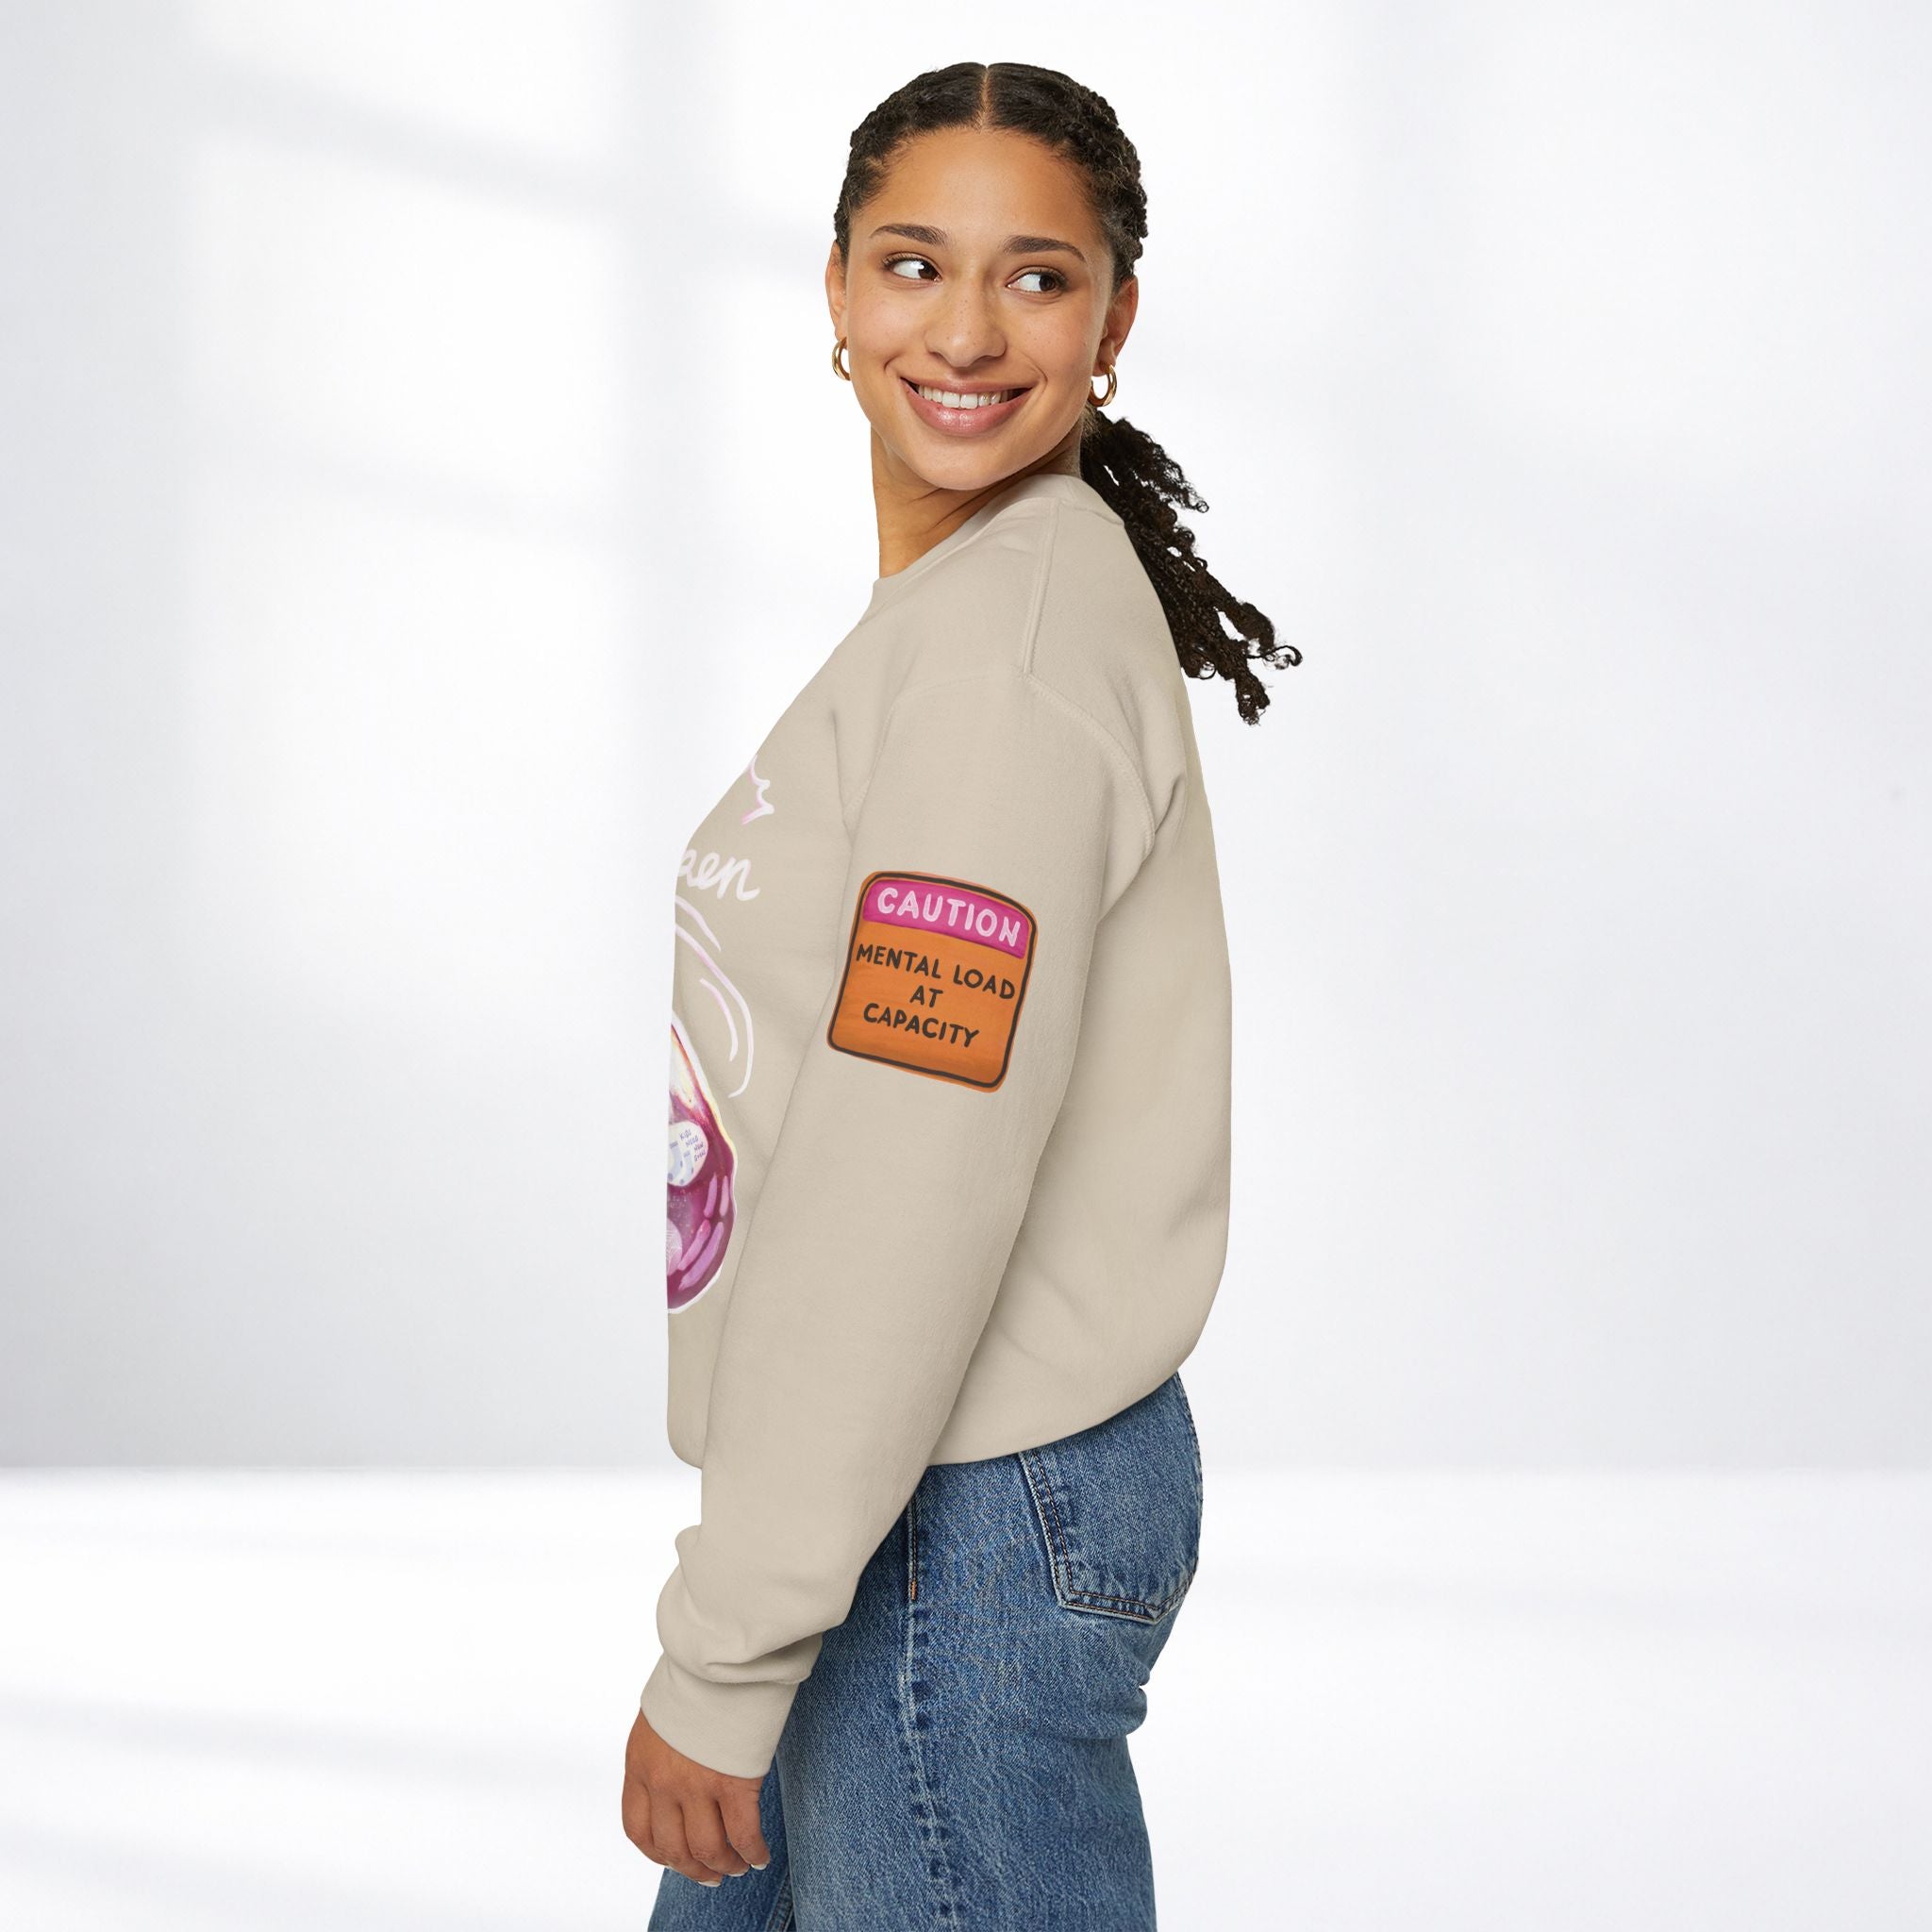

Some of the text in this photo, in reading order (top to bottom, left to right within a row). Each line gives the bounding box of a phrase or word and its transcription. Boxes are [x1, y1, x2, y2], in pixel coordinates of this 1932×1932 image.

[877, 887, 1021, 947] CAUTION
[856, 943, 1016, 999] MENTAL LOAD
[909, 985, 943, 1008] AT
[863, 1003, 980, 1048] CAPACITY
